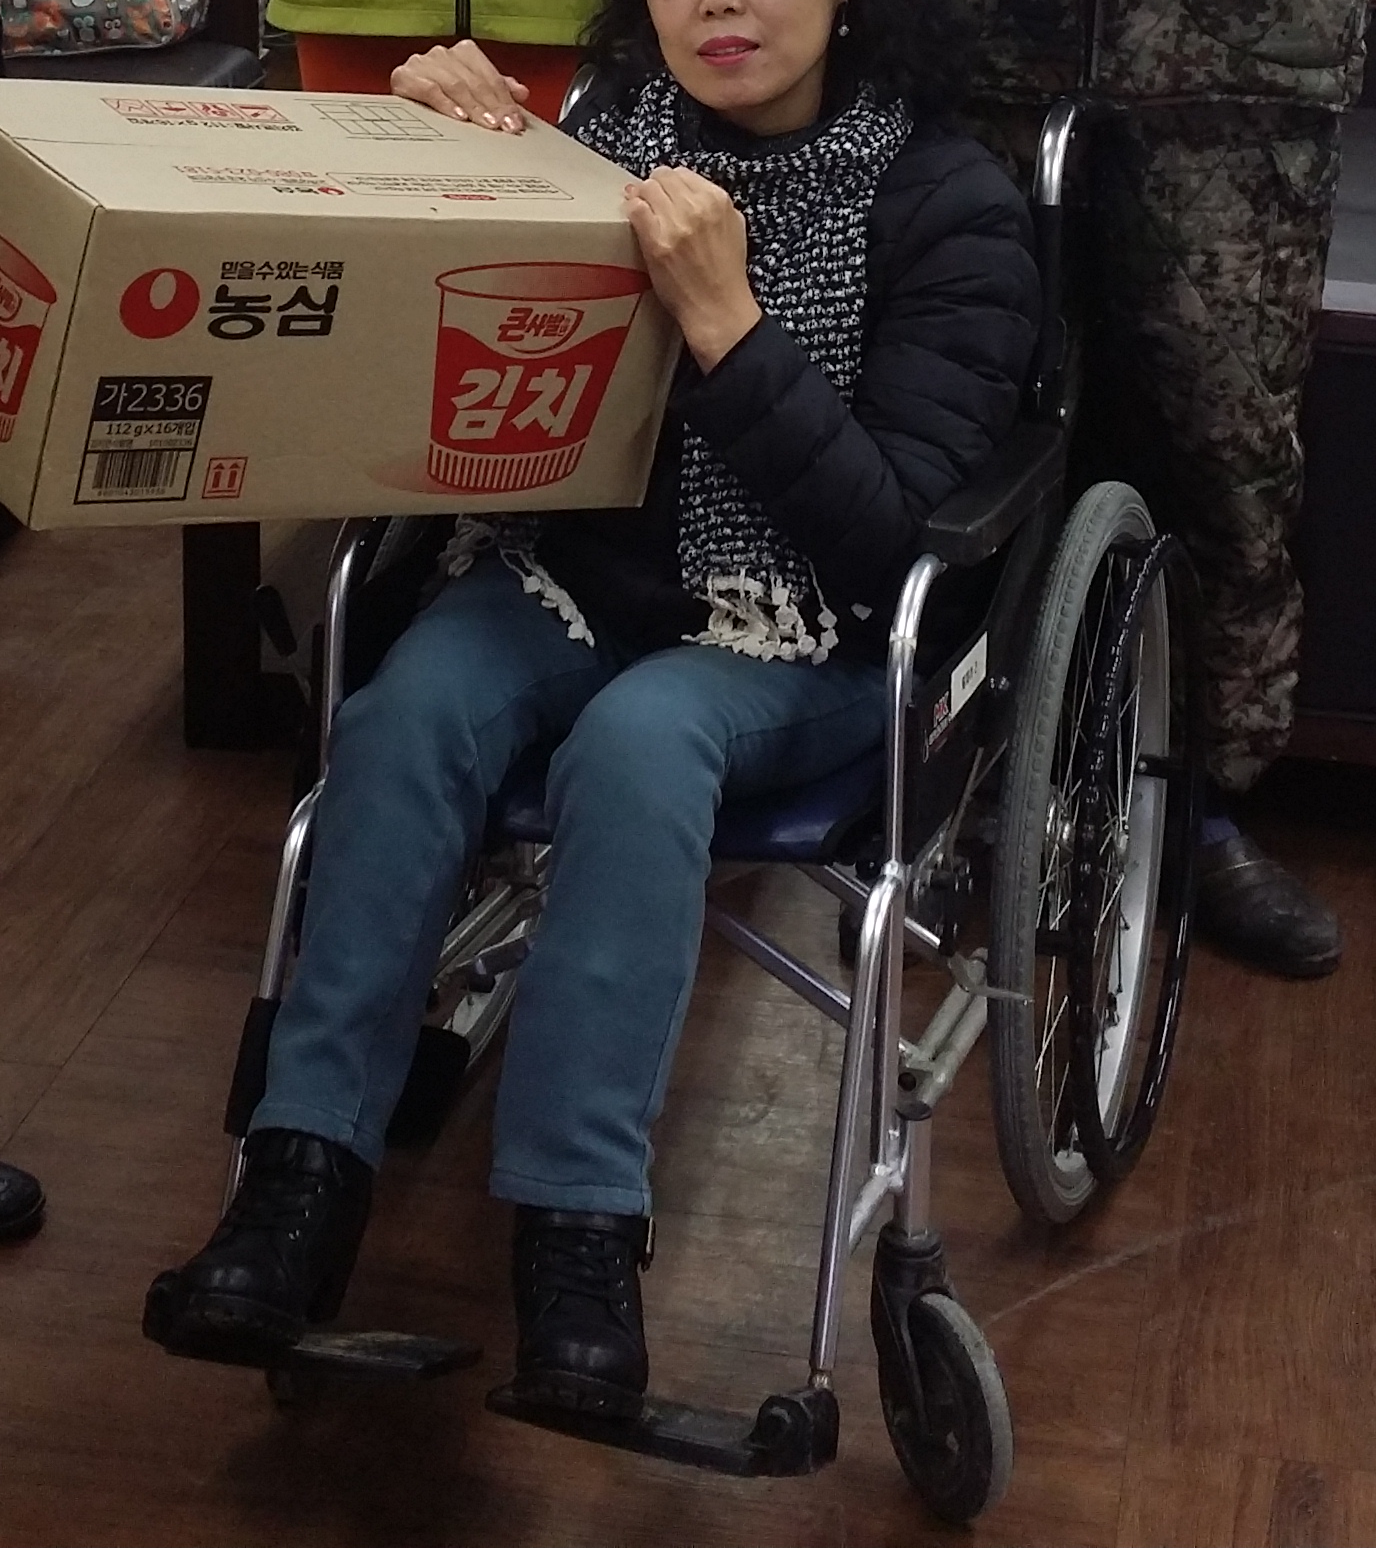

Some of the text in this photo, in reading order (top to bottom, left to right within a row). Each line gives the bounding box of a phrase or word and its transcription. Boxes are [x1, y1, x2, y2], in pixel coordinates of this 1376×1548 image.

[208, 284, 339, 340] 농심
[100, 383, 204, 414] 가2336
[448, 364, 593, 440] 김치
